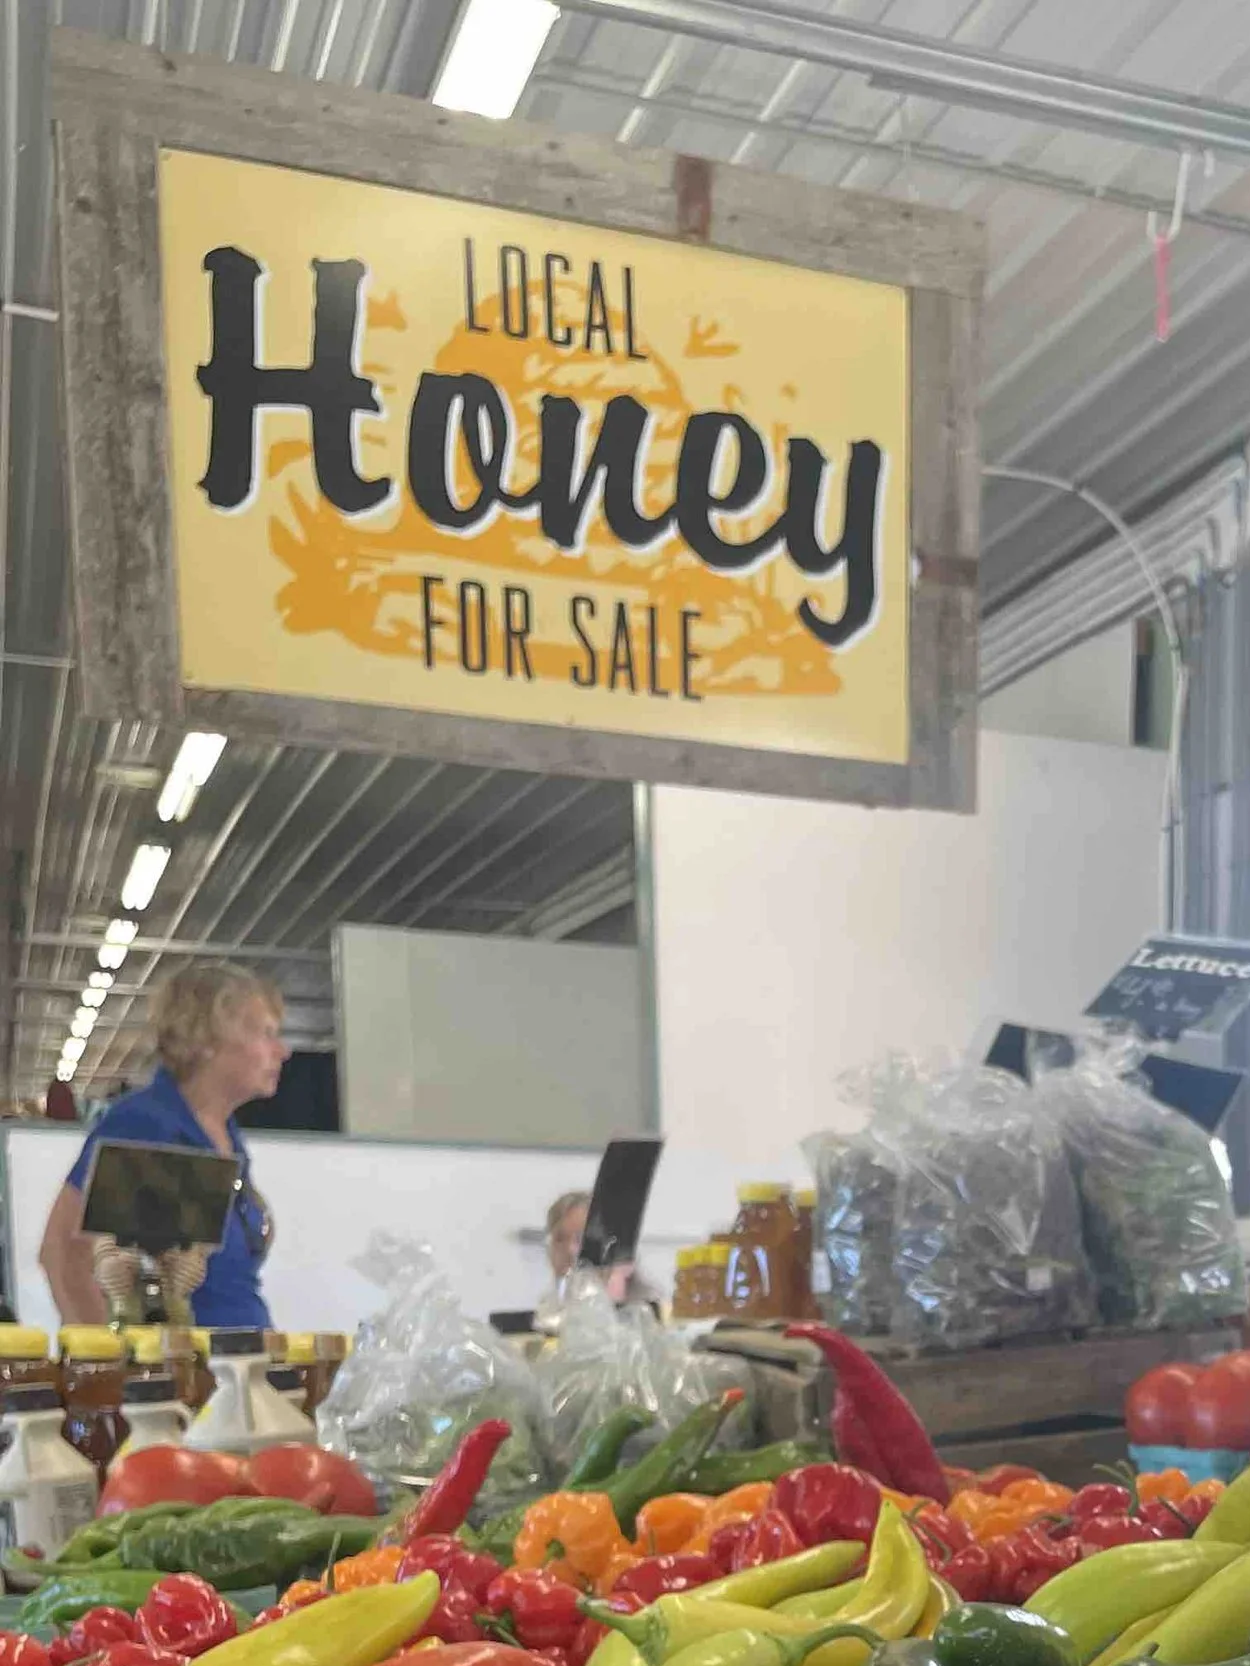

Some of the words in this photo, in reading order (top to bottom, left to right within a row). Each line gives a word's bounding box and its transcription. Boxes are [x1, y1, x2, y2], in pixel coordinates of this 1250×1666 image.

[464, 237, 648, 359] LOCAL
[196, 246, 884, 648] Honey
[420, 576, 532, 682] FOR
[571, 596, 706, 701] SALE
